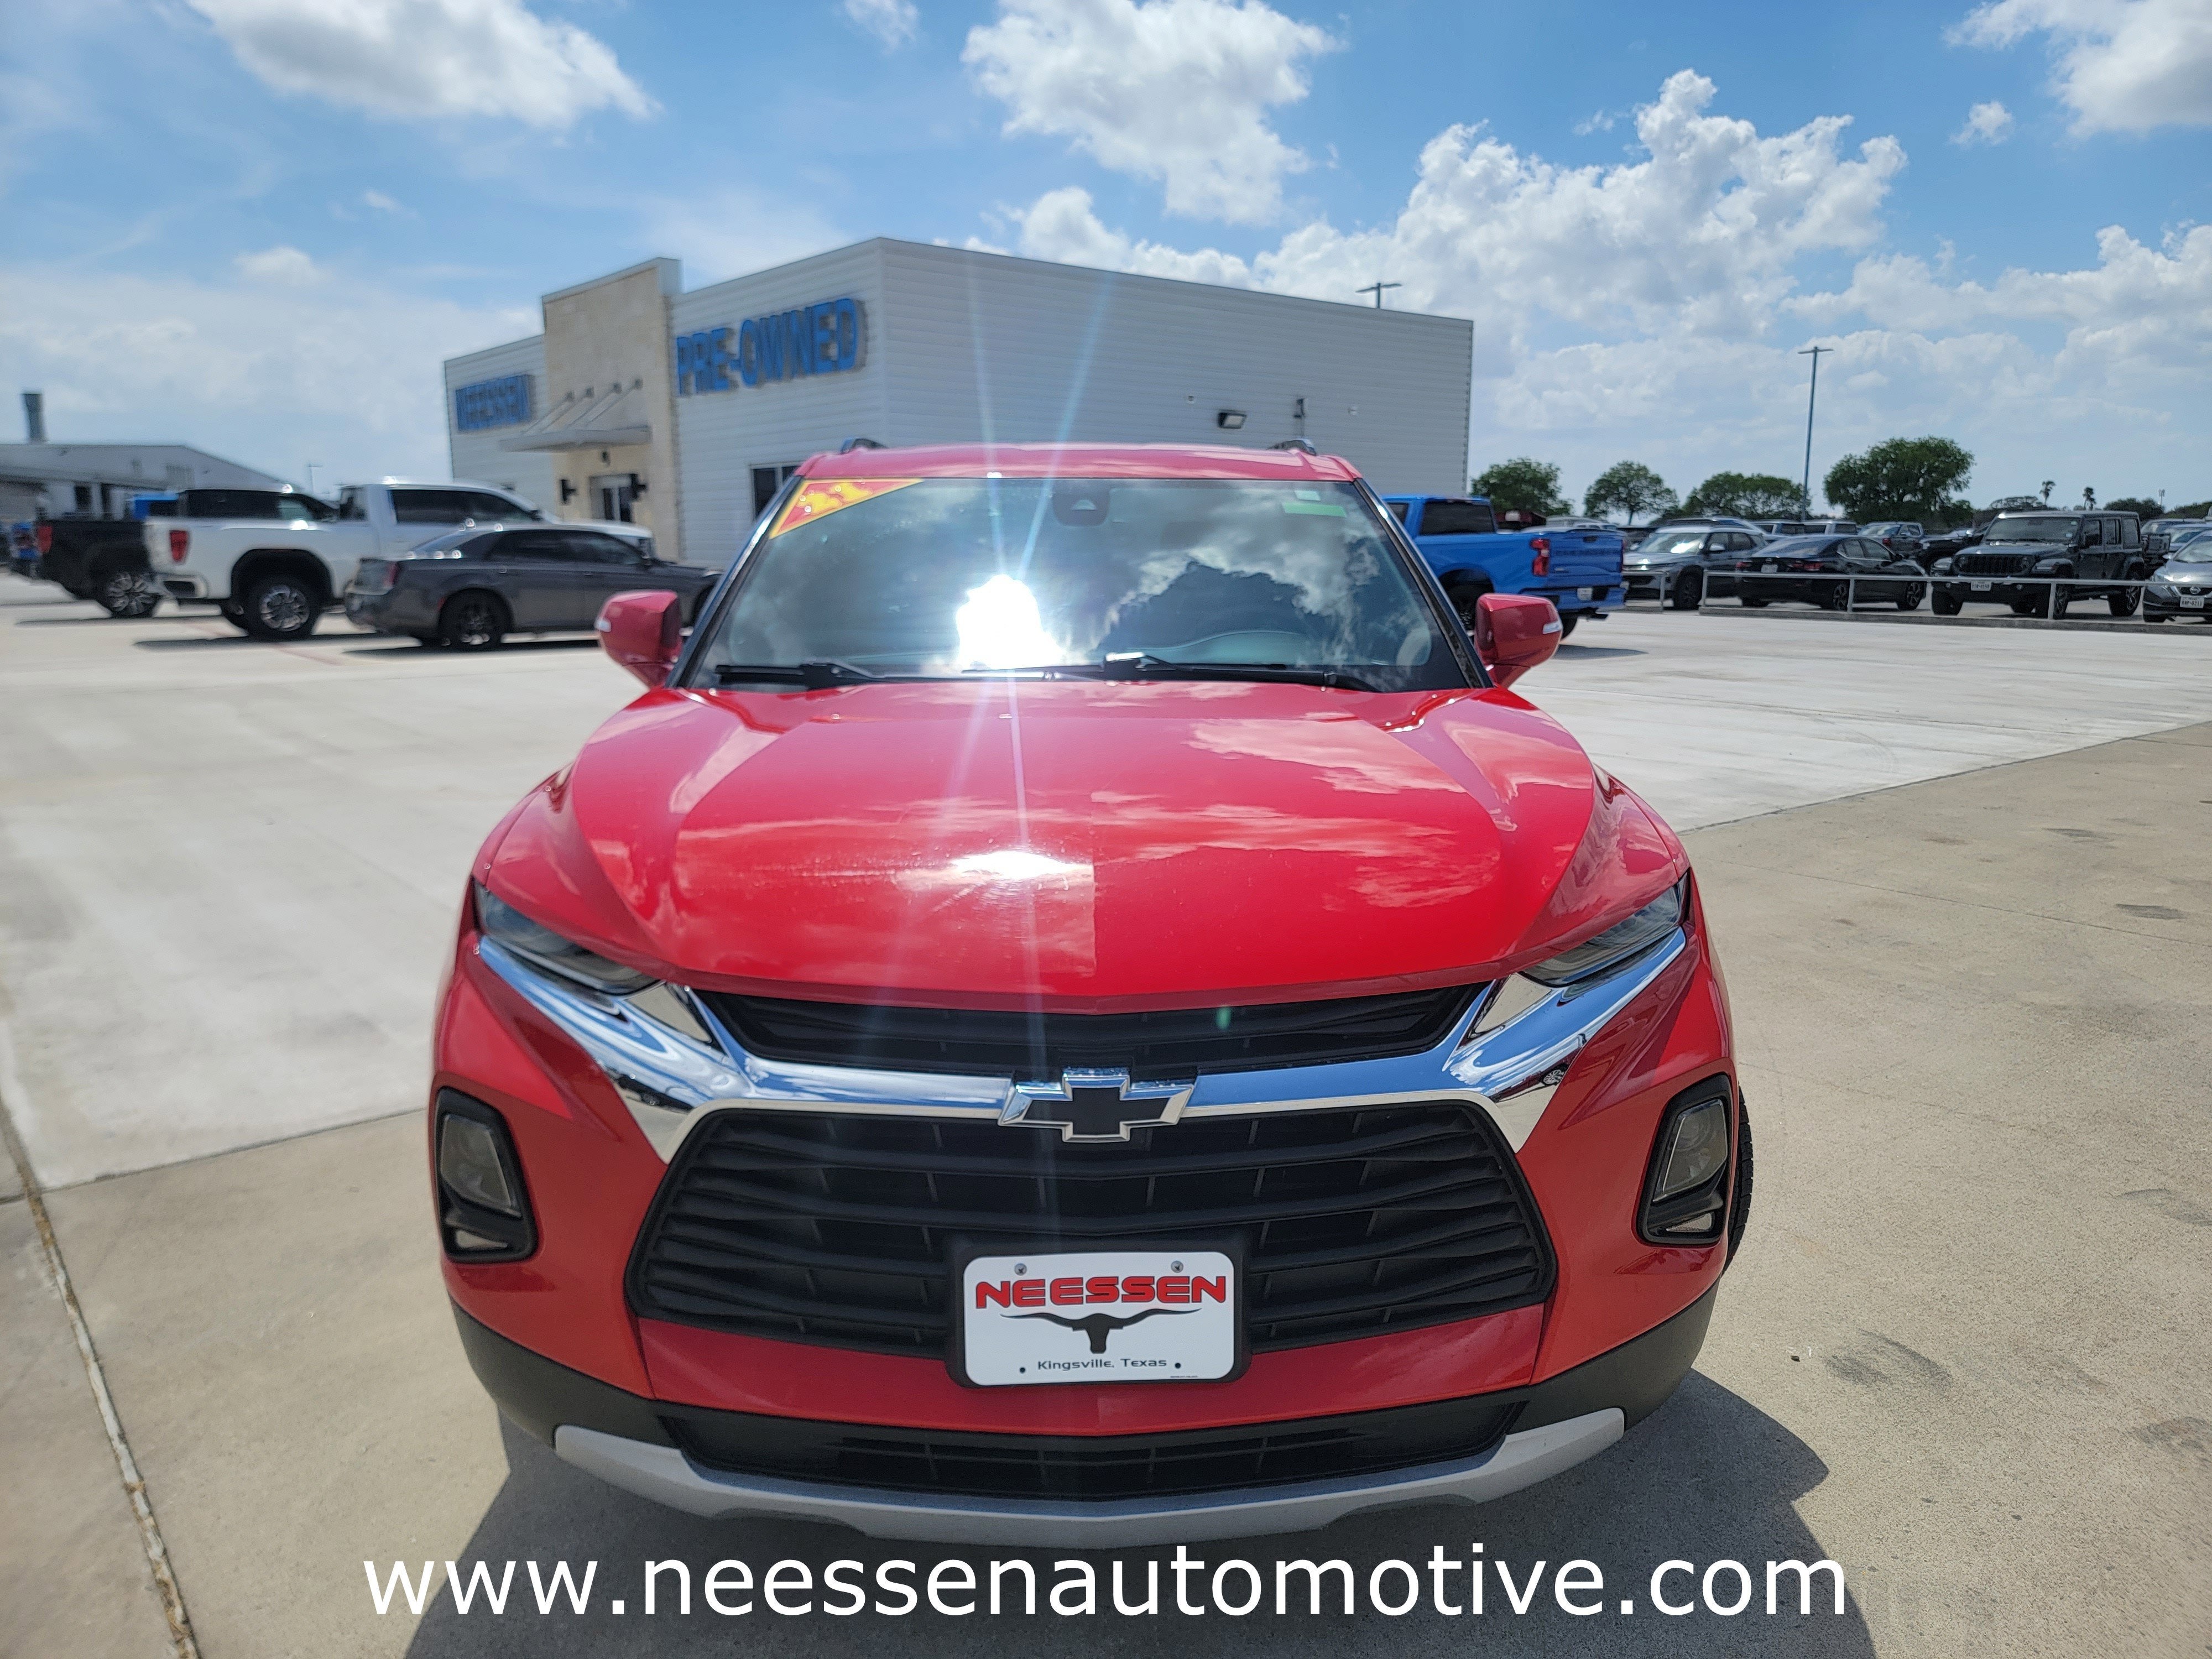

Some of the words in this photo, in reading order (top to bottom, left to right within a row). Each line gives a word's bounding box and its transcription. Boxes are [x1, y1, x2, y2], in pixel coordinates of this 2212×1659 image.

[677, 298, 859, 397] PRE-OWNED
[976, 1276, 1226, 1309] NEESSEN
[1037, 1359, 1115, 1371] Kingsville,
[1120, 1358, 1167, 1368] Texas
